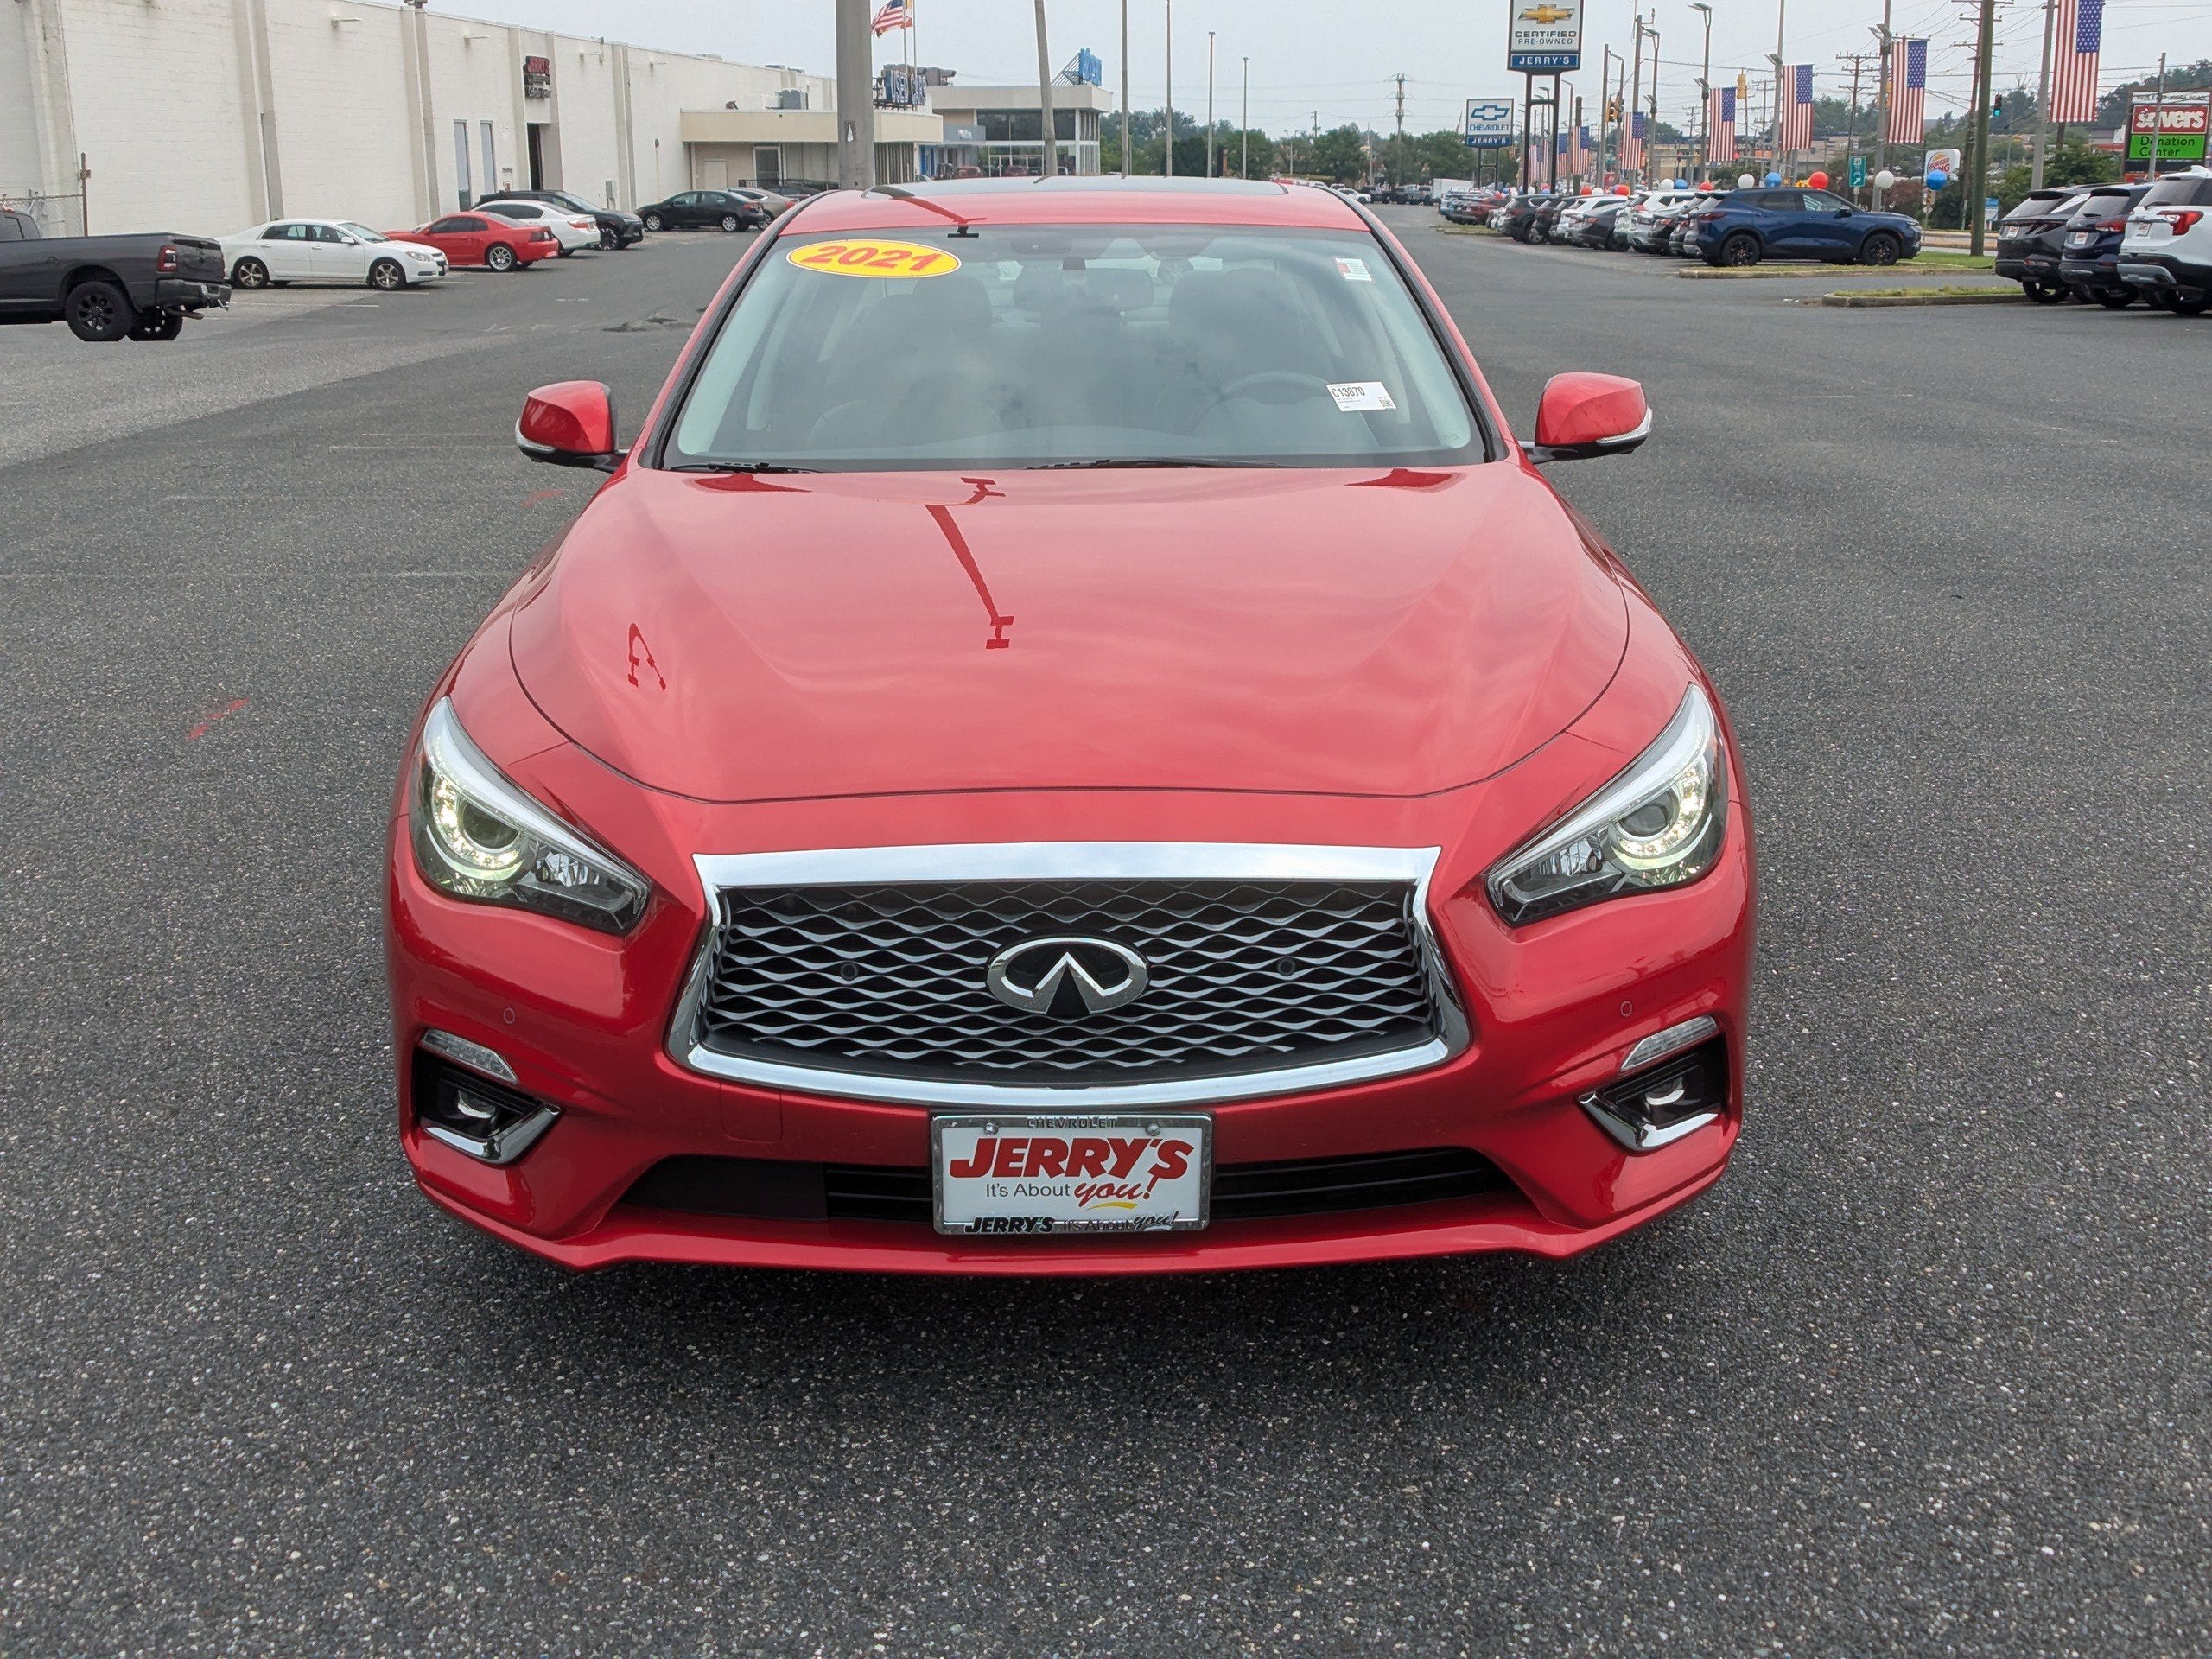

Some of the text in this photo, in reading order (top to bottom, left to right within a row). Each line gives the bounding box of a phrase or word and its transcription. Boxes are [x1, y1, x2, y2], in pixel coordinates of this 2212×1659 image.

[1519, 56, 1570, 65] JERRY'S
[1929, 157, 1950, 170] BURGER
[800, 245, 944, 272] 2021
[1331, 386, 1366, 398] C13870
[1027, 1116, 1118, 1128] CHEVROLET
[949, 1136, 1194, 1179] JERRY'S
[986, 1173, 1160, 1208] It's About you!
[963, 1211, 1180, 1234] JERRY'S It's About you!
